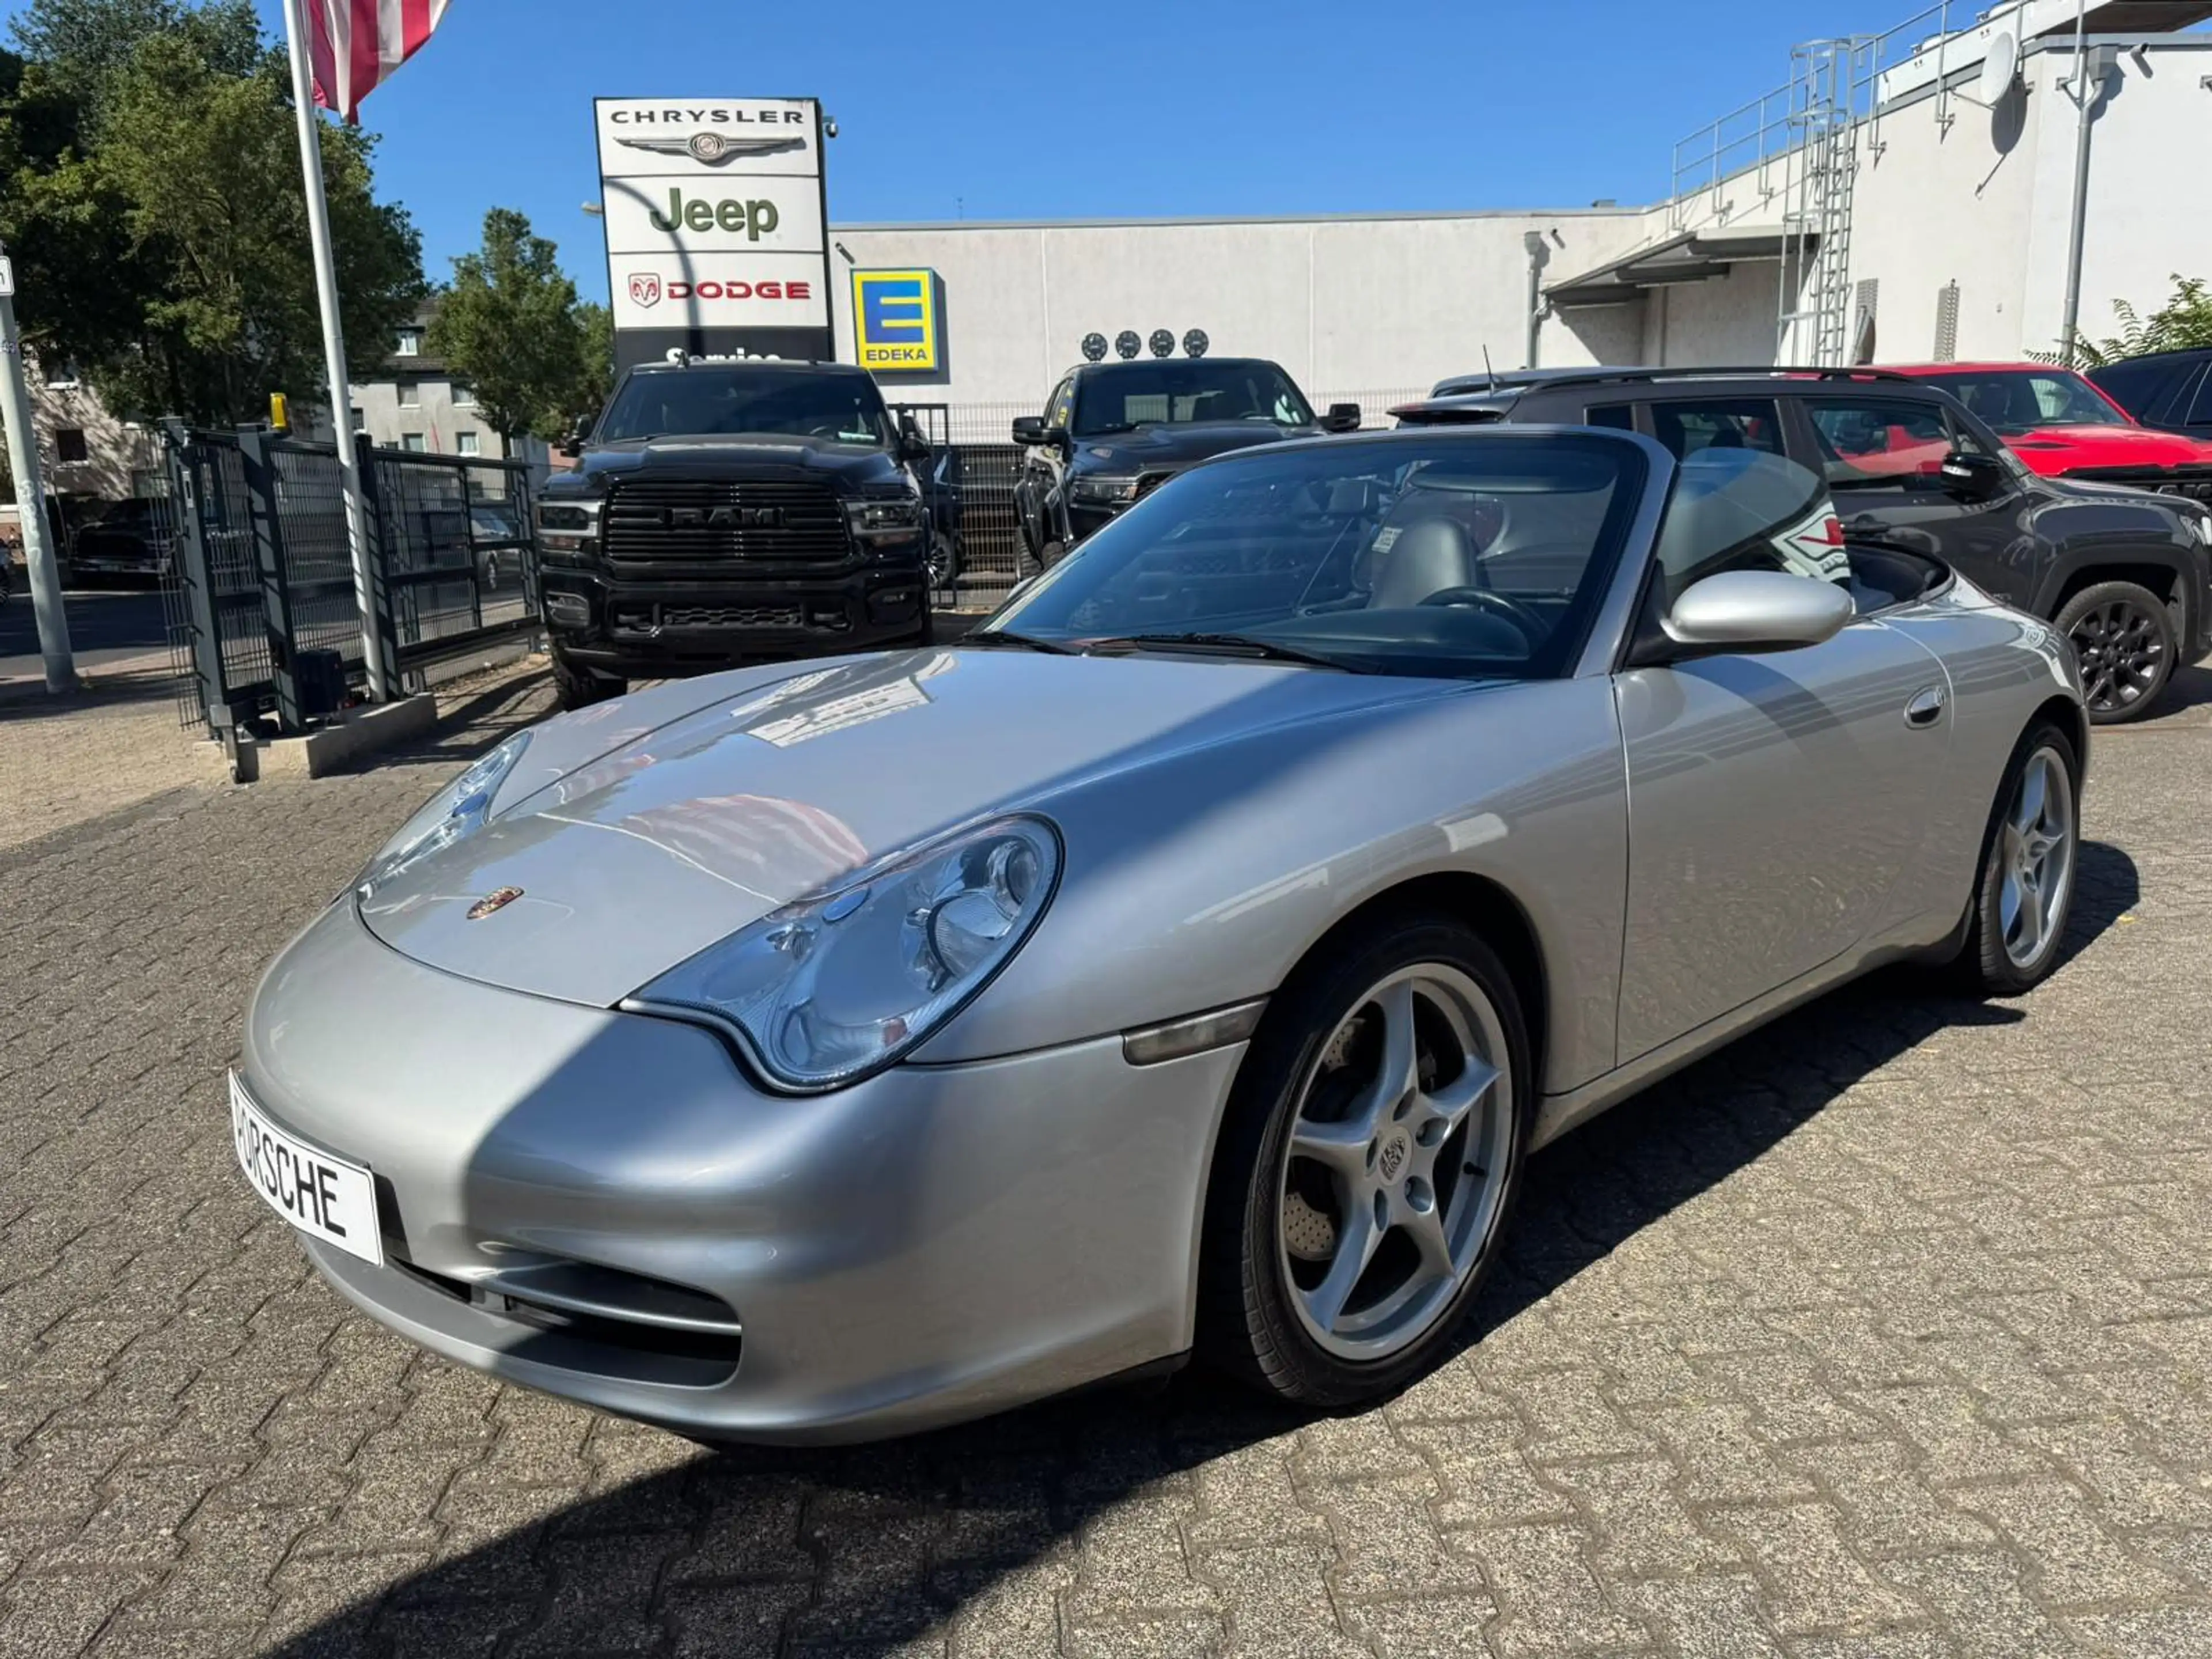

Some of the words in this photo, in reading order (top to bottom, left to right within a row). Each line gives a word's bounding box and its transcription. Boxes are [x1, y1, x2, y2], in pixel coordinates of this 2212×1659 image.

[611, 110, 804, 123] CHRYSLER
[650, 188, 779, 241] Jeep
[667, 282, 811, 299] DODGE
[866, 349, 927, 360] EDEKA
[671, 507, 775, 525] RAM
[234, 1094, 346, 1237] PORSCHE
